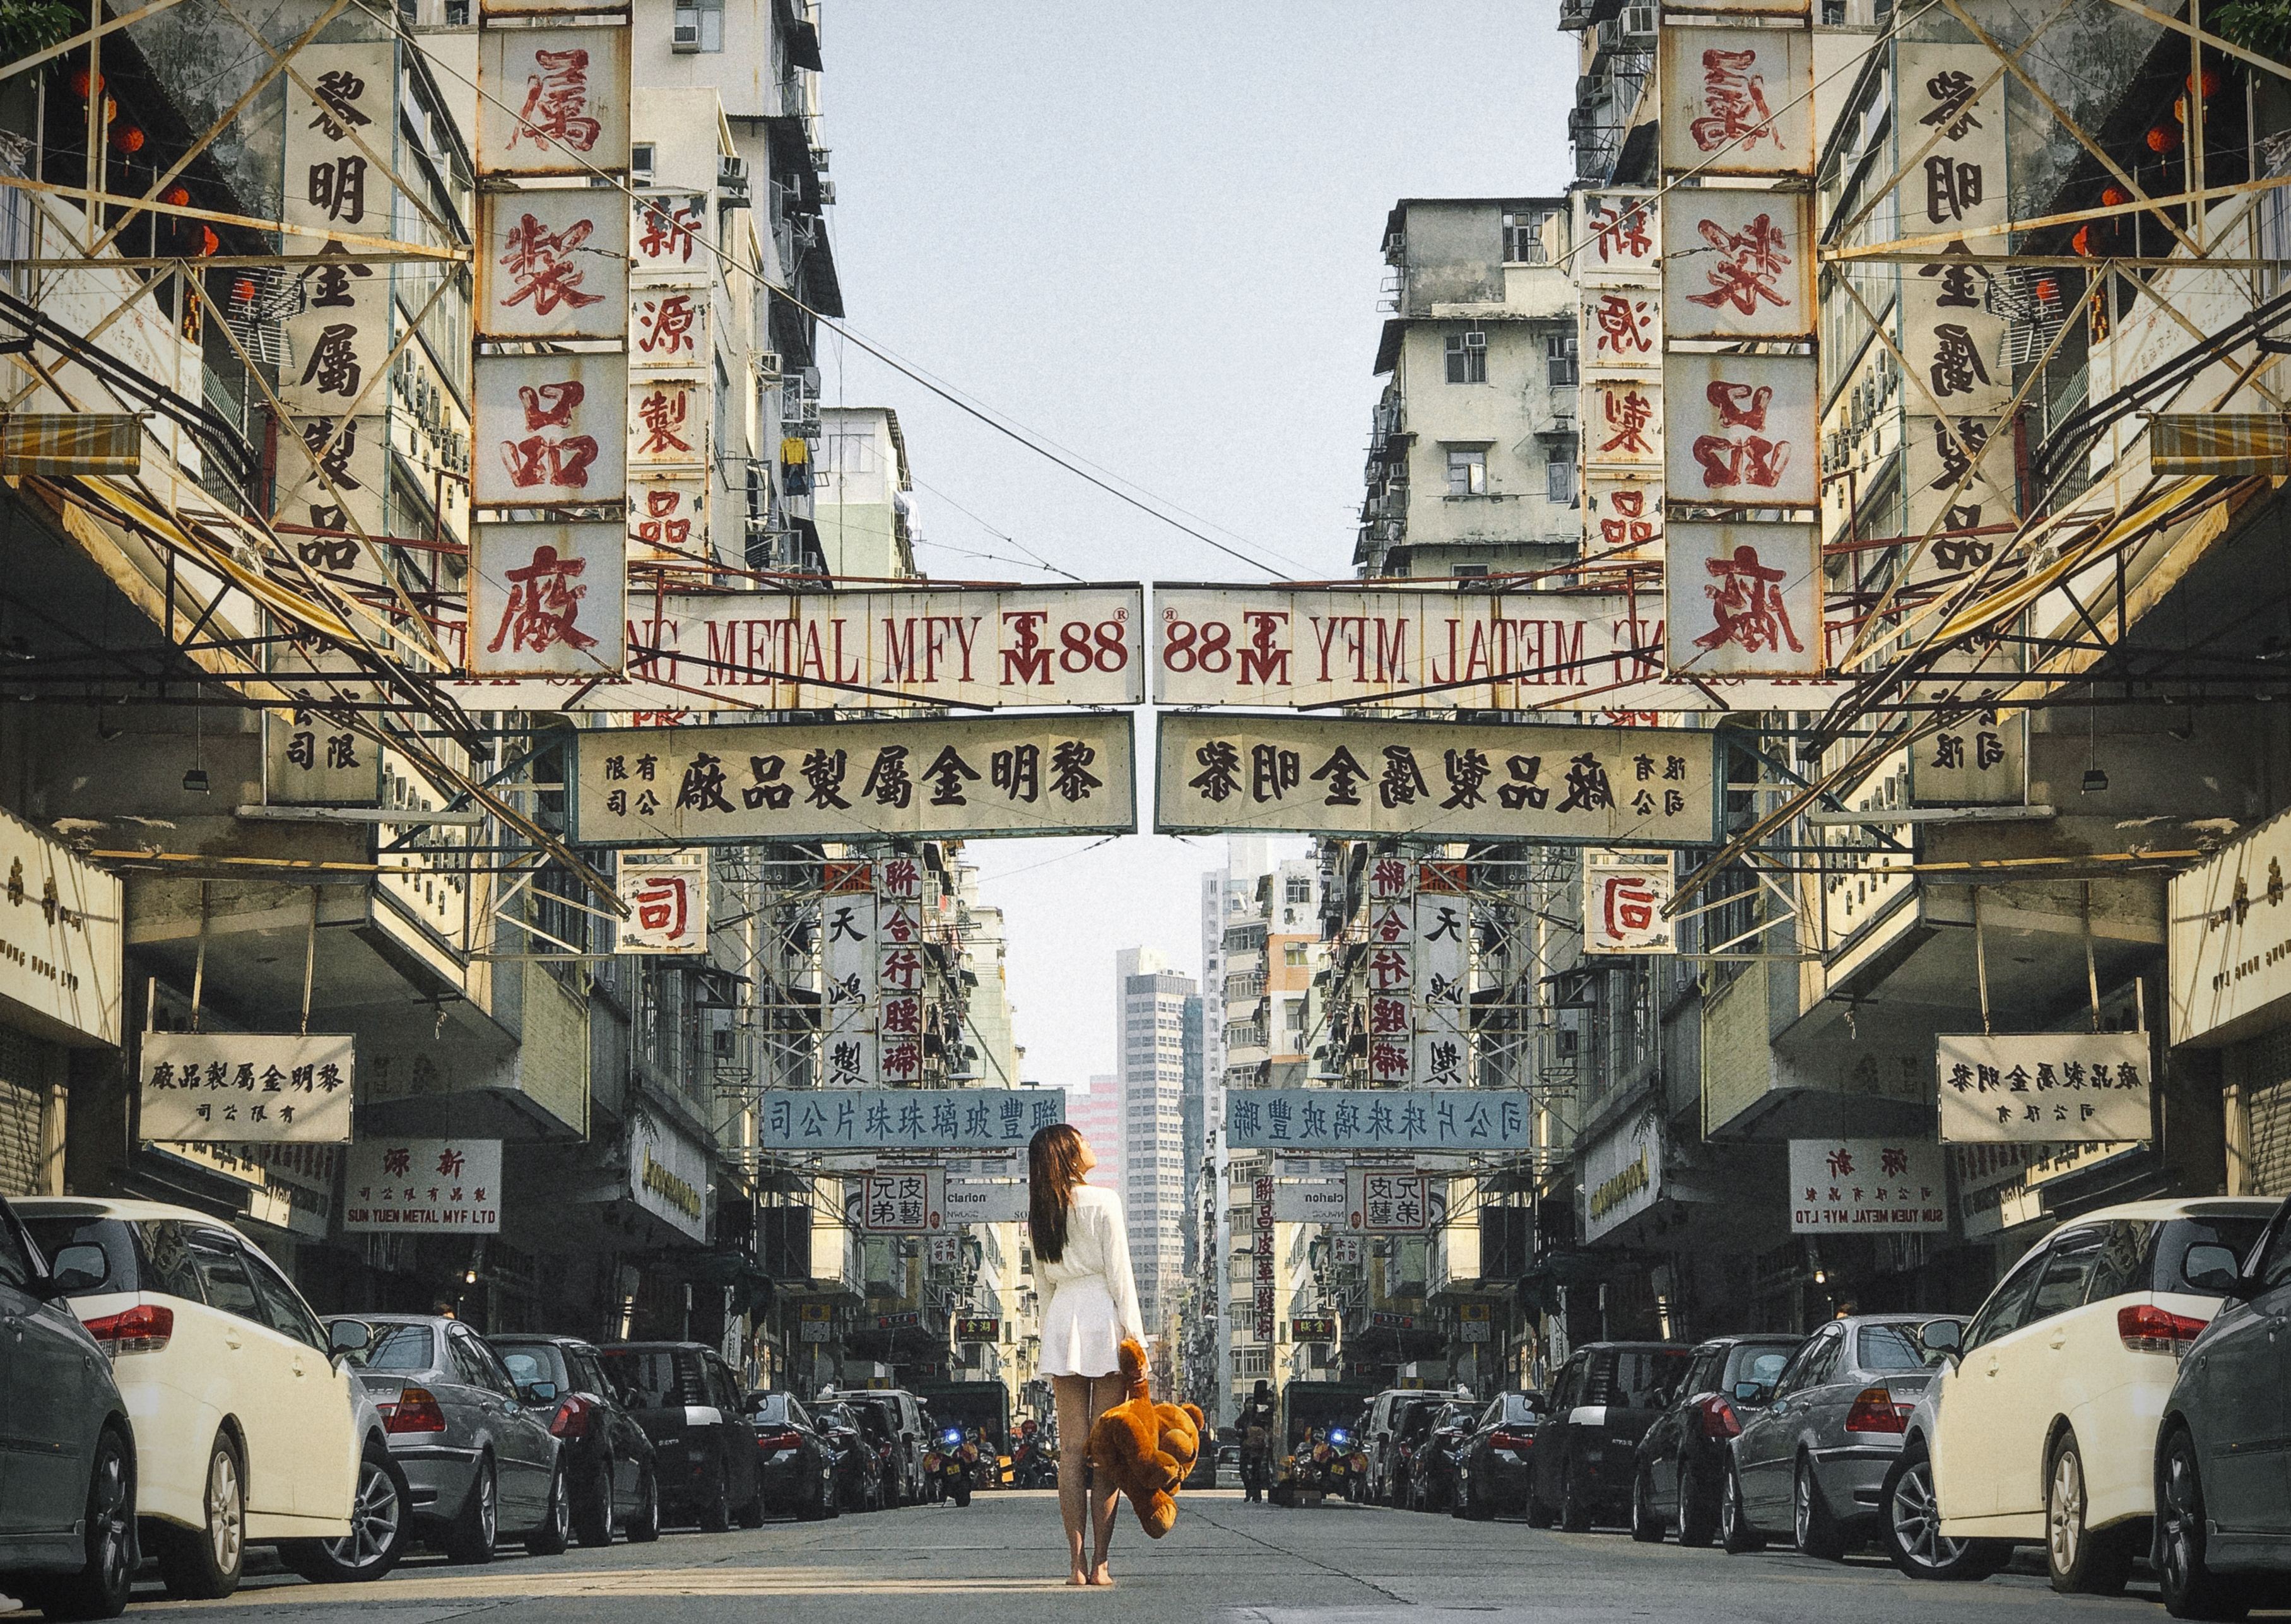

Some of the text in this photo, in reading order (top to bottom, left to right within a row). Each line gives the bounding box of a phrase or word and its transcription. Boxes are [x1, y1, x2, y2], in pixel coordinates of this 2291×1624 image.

[704, 618, 861, 685] METAL
[882, 615, 982, 685] MFY
[1060, 620, 1128, 673] 88
[348, 1209, 496, 1223] SUN YUEN METAL MYF LTD
